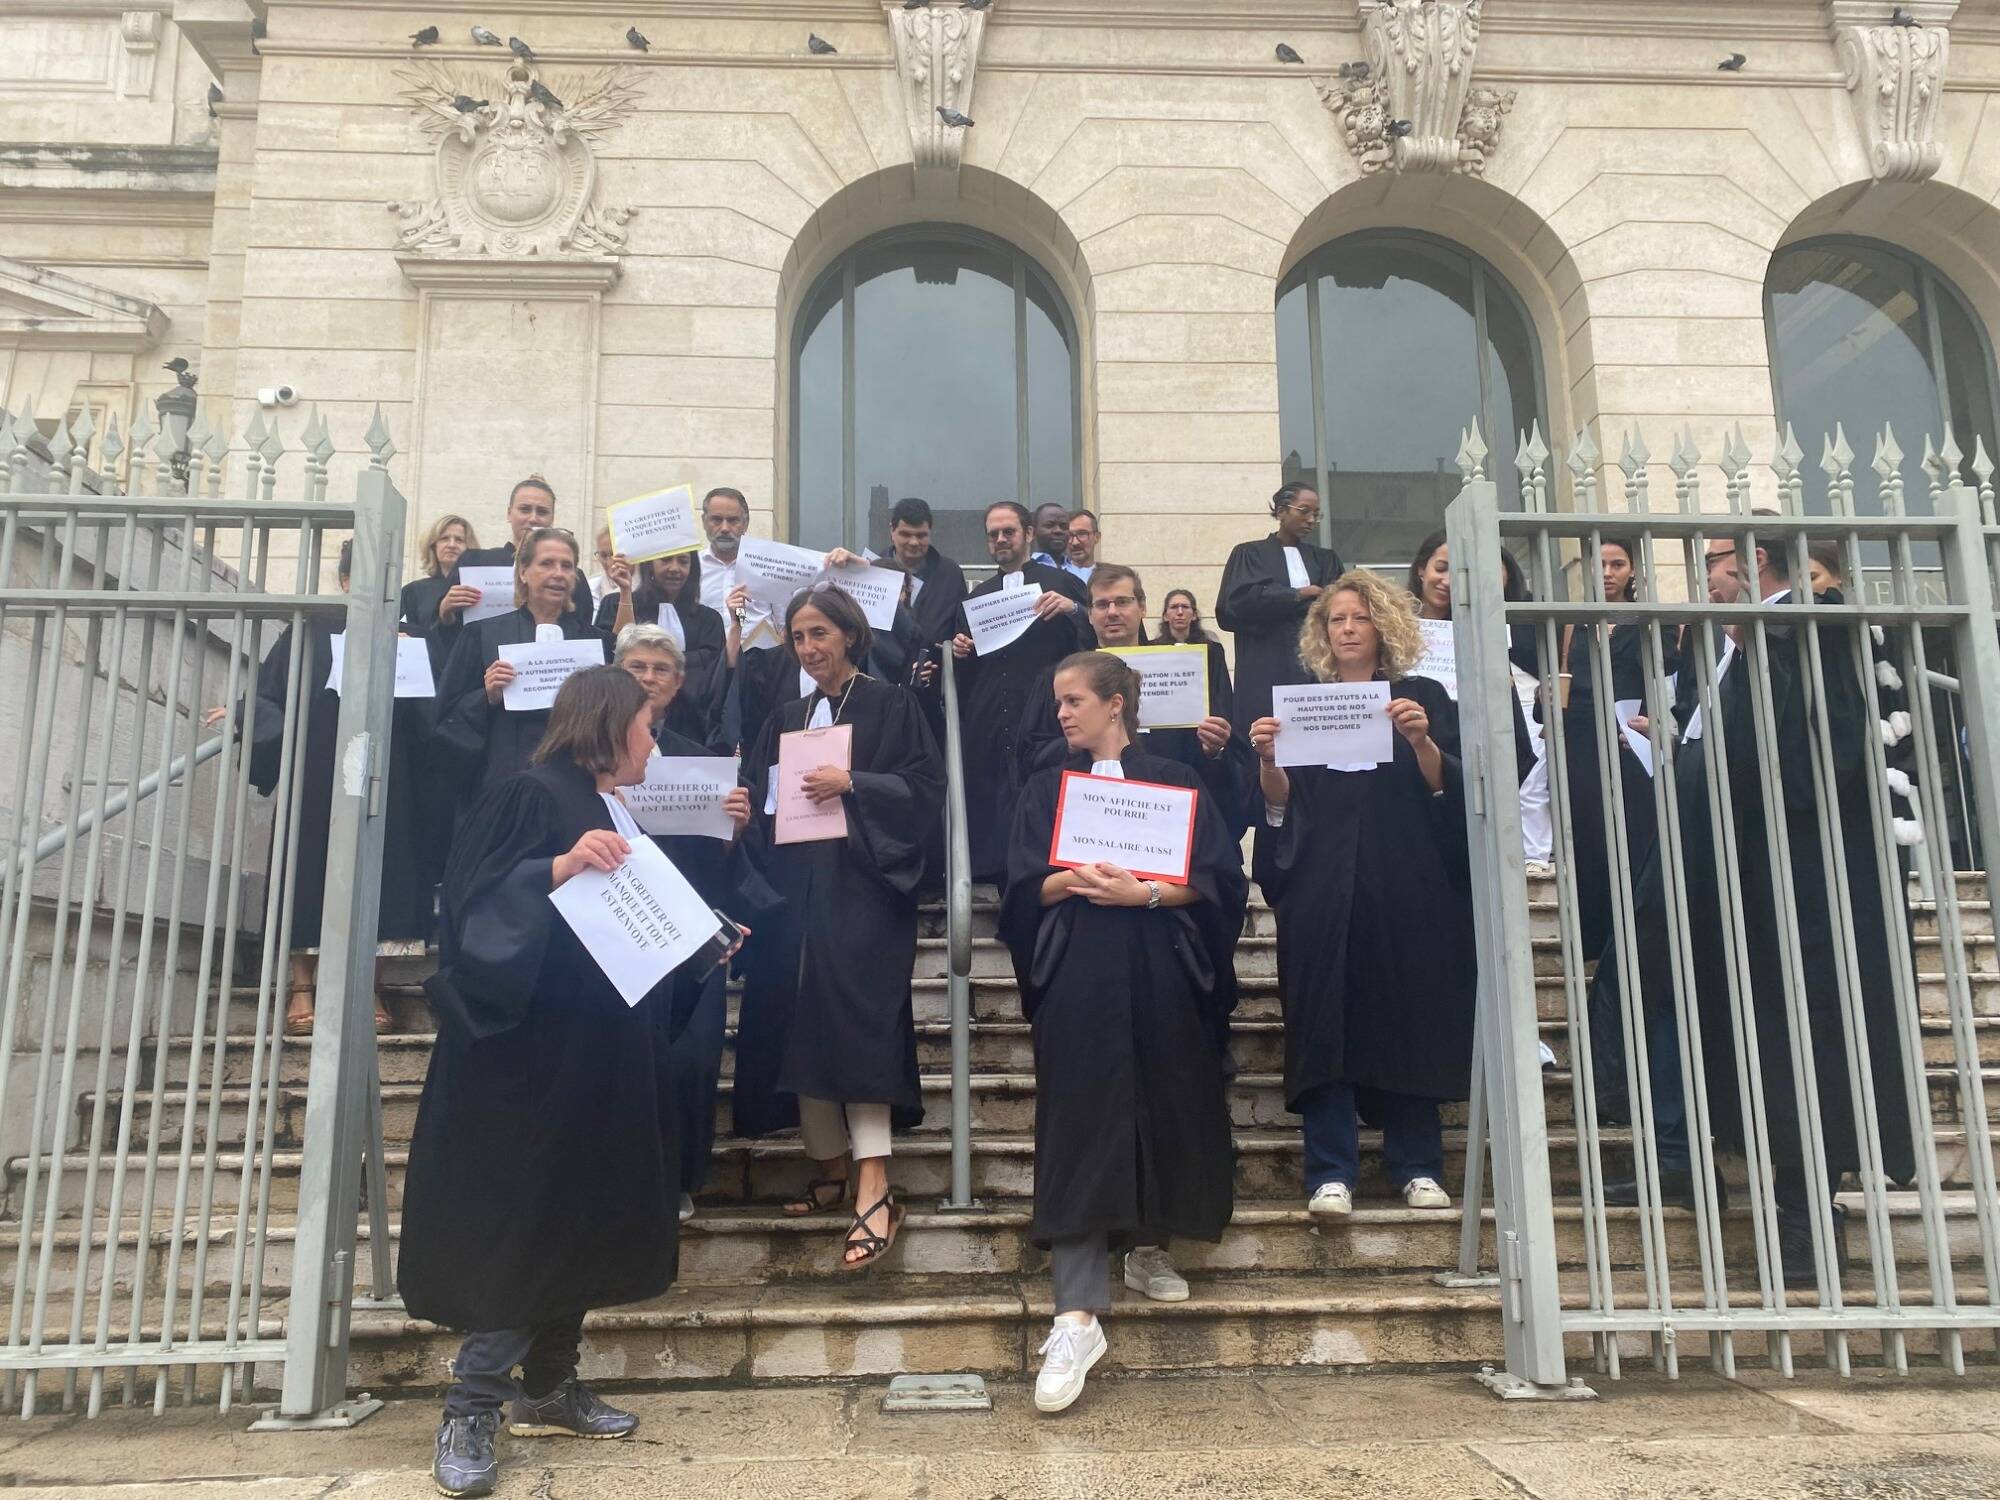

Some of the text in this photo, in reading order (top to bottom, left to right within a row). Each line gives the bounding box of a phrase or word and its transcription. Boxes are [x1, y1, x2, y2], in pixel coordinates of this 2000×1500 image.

[1324, 694, 1360, 702] STATUTS
[1298, 704, 1335, 712] HAUTEUR
[1291, 714, 1348, 722] COMPETENCES
[701, 784, 719, 792] QUI
[632, 795, 674, 803] MANQUE
[1082, 793, 1172, 812] MON AFFICHE EST
[662, 804, 708, 812] RENVOYE
[1104, 807, 1148, 820] POURRIE
[1072, 836, 1172, 856] MON SALAIRE AUSSI
[620, 864, 682, 941] UN GREFFIER QUI
[608, 872, 668, 949] MANQUE ET TOUT
[600, 889, 650, 951] EST RENVOYE
